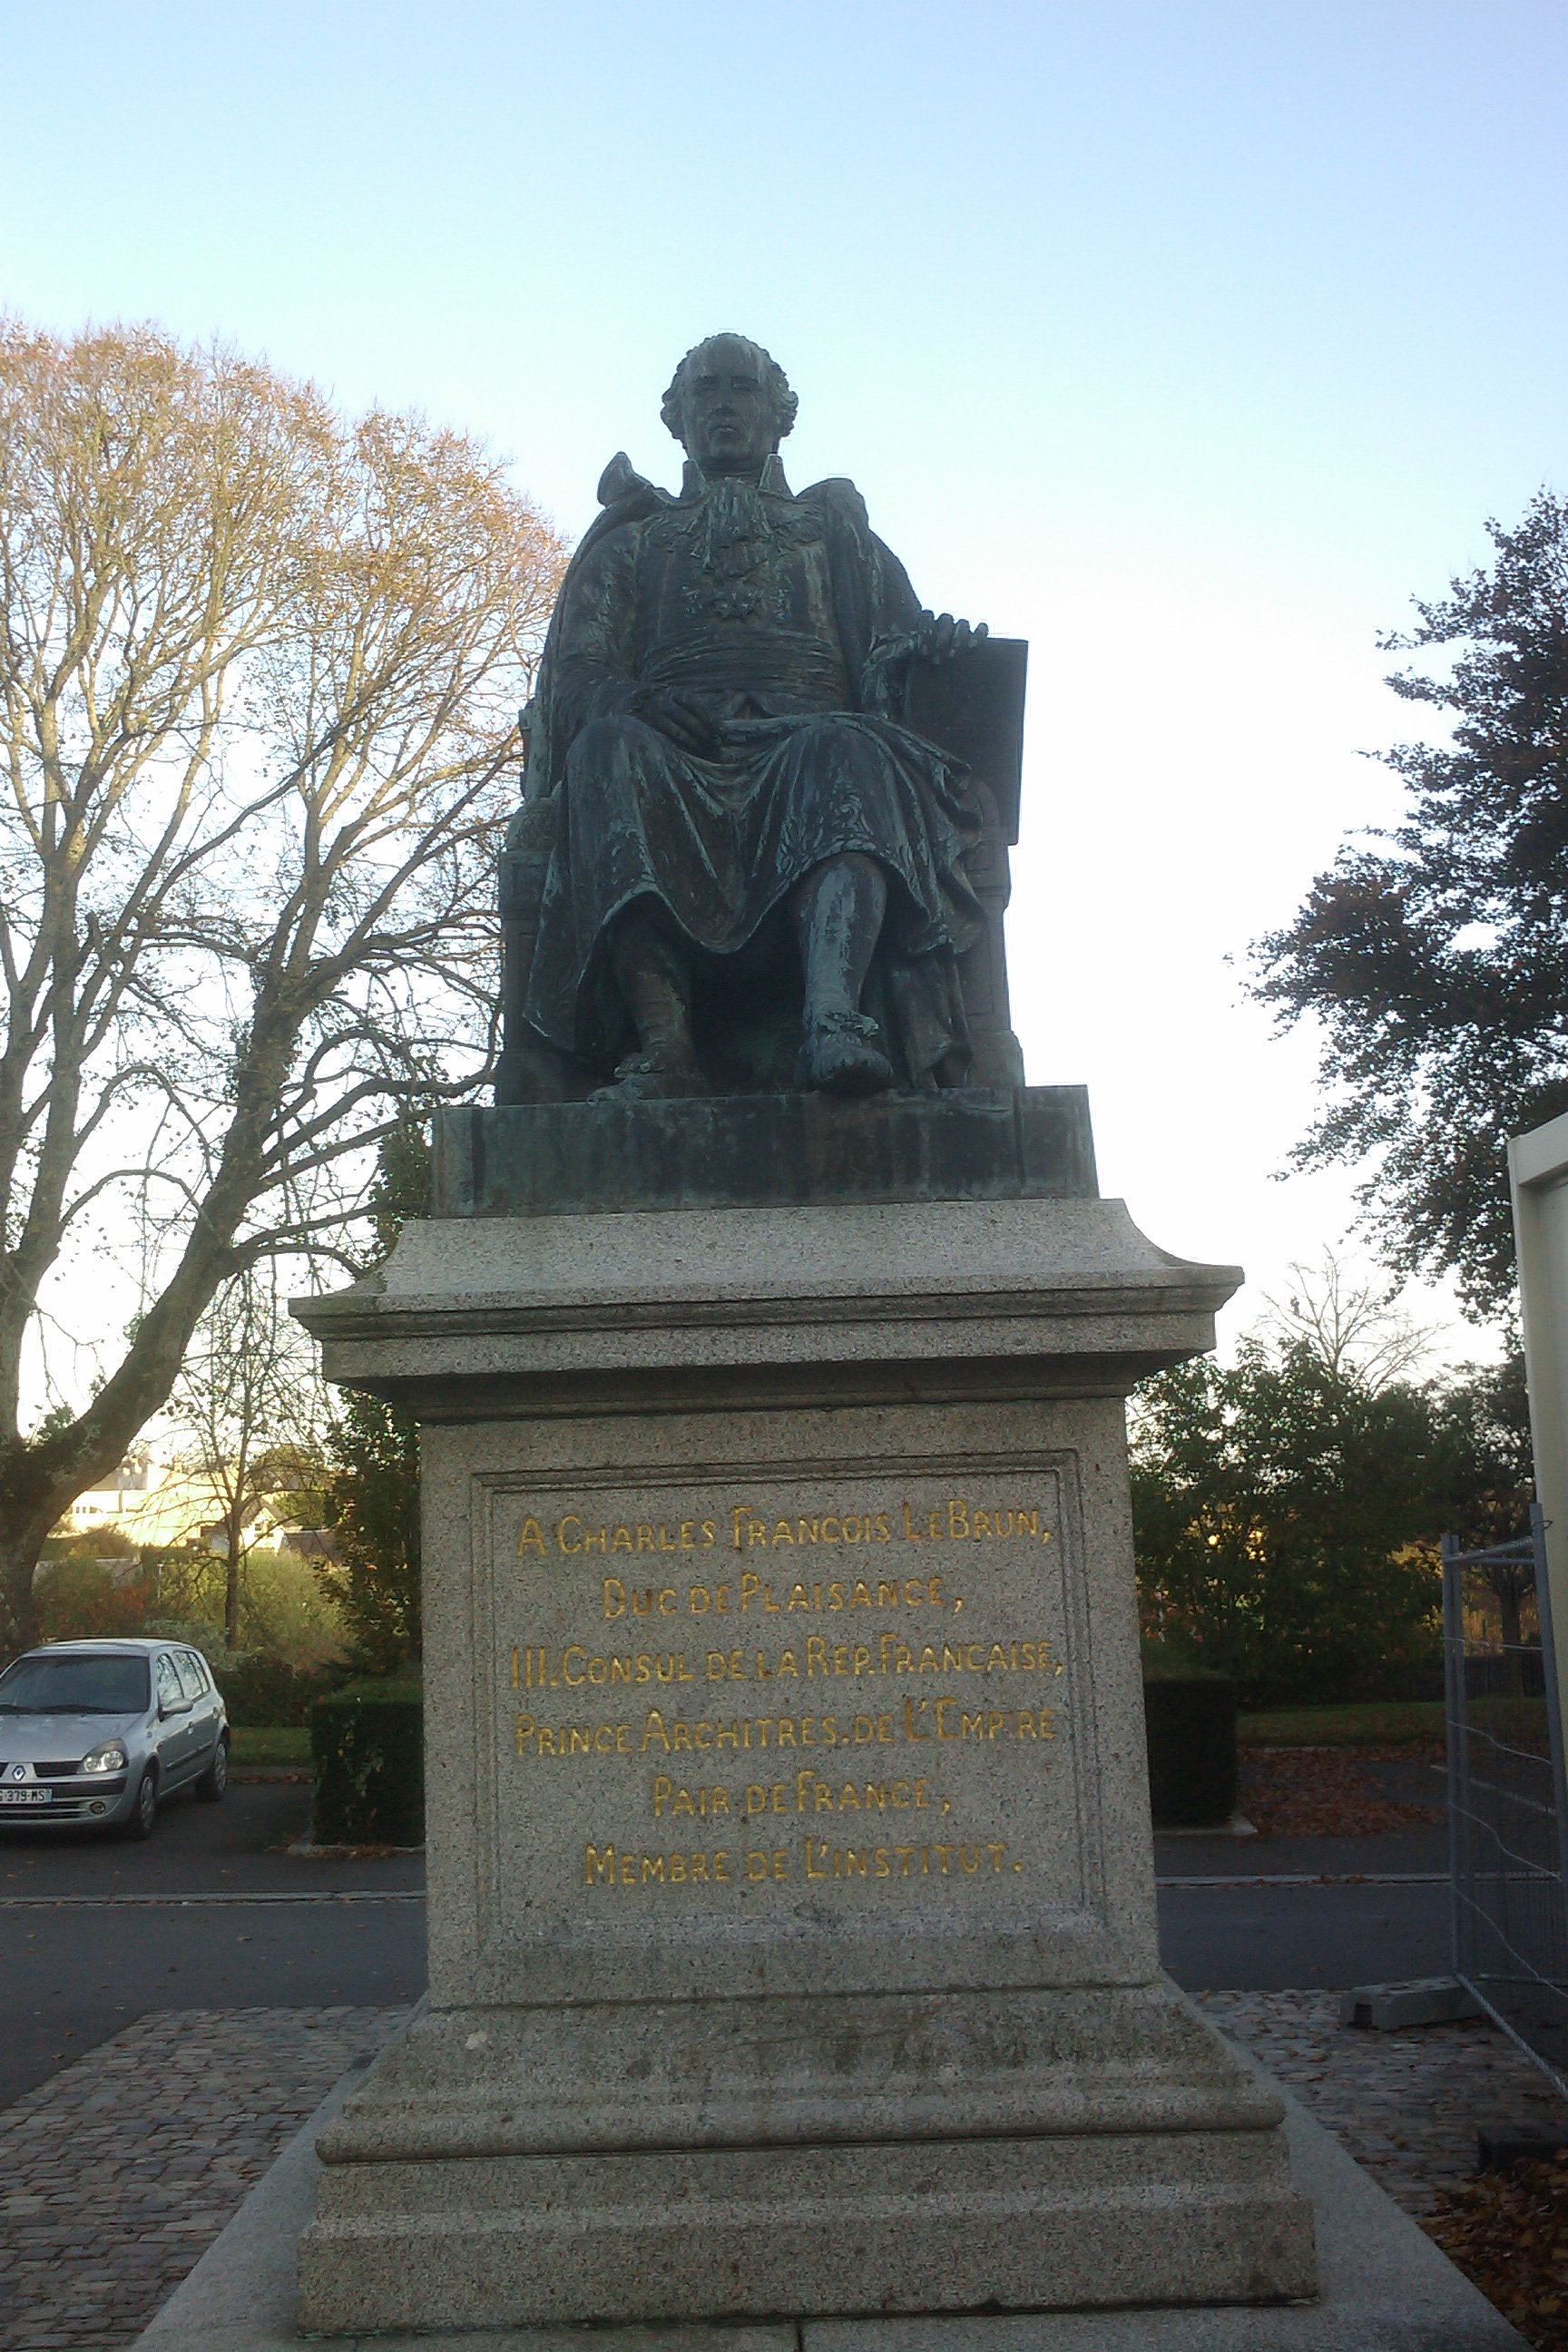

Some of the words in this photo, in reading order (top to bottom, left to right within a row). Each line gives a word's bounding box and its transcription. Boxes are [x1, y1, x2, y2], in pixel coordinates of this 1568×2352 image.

[516, 1516, 546, 1558] A
[556, 1514, 717, 1554] CHARLES
[603, 1577, 678, 1619] DUC
[689, 1585, 731, 1614] DE
[740, 1572, 964, 1613] PLAISANCE,
[706, 1651, 746, 1680] DE
[756, 1649, 799, 1679] LA
[515, 1713, 633, 1757] PRINCE
[853, 1714, 895, 1744] DE
[652, 1775, 730, 1818] PAIR
[745, 1784, 789, 1814] DE
[797, 1769, 951, 1816] FRANCE,
[583, 1843, 730, 1885] MEMBRE
[747, 1850, 789, 1881] DE
